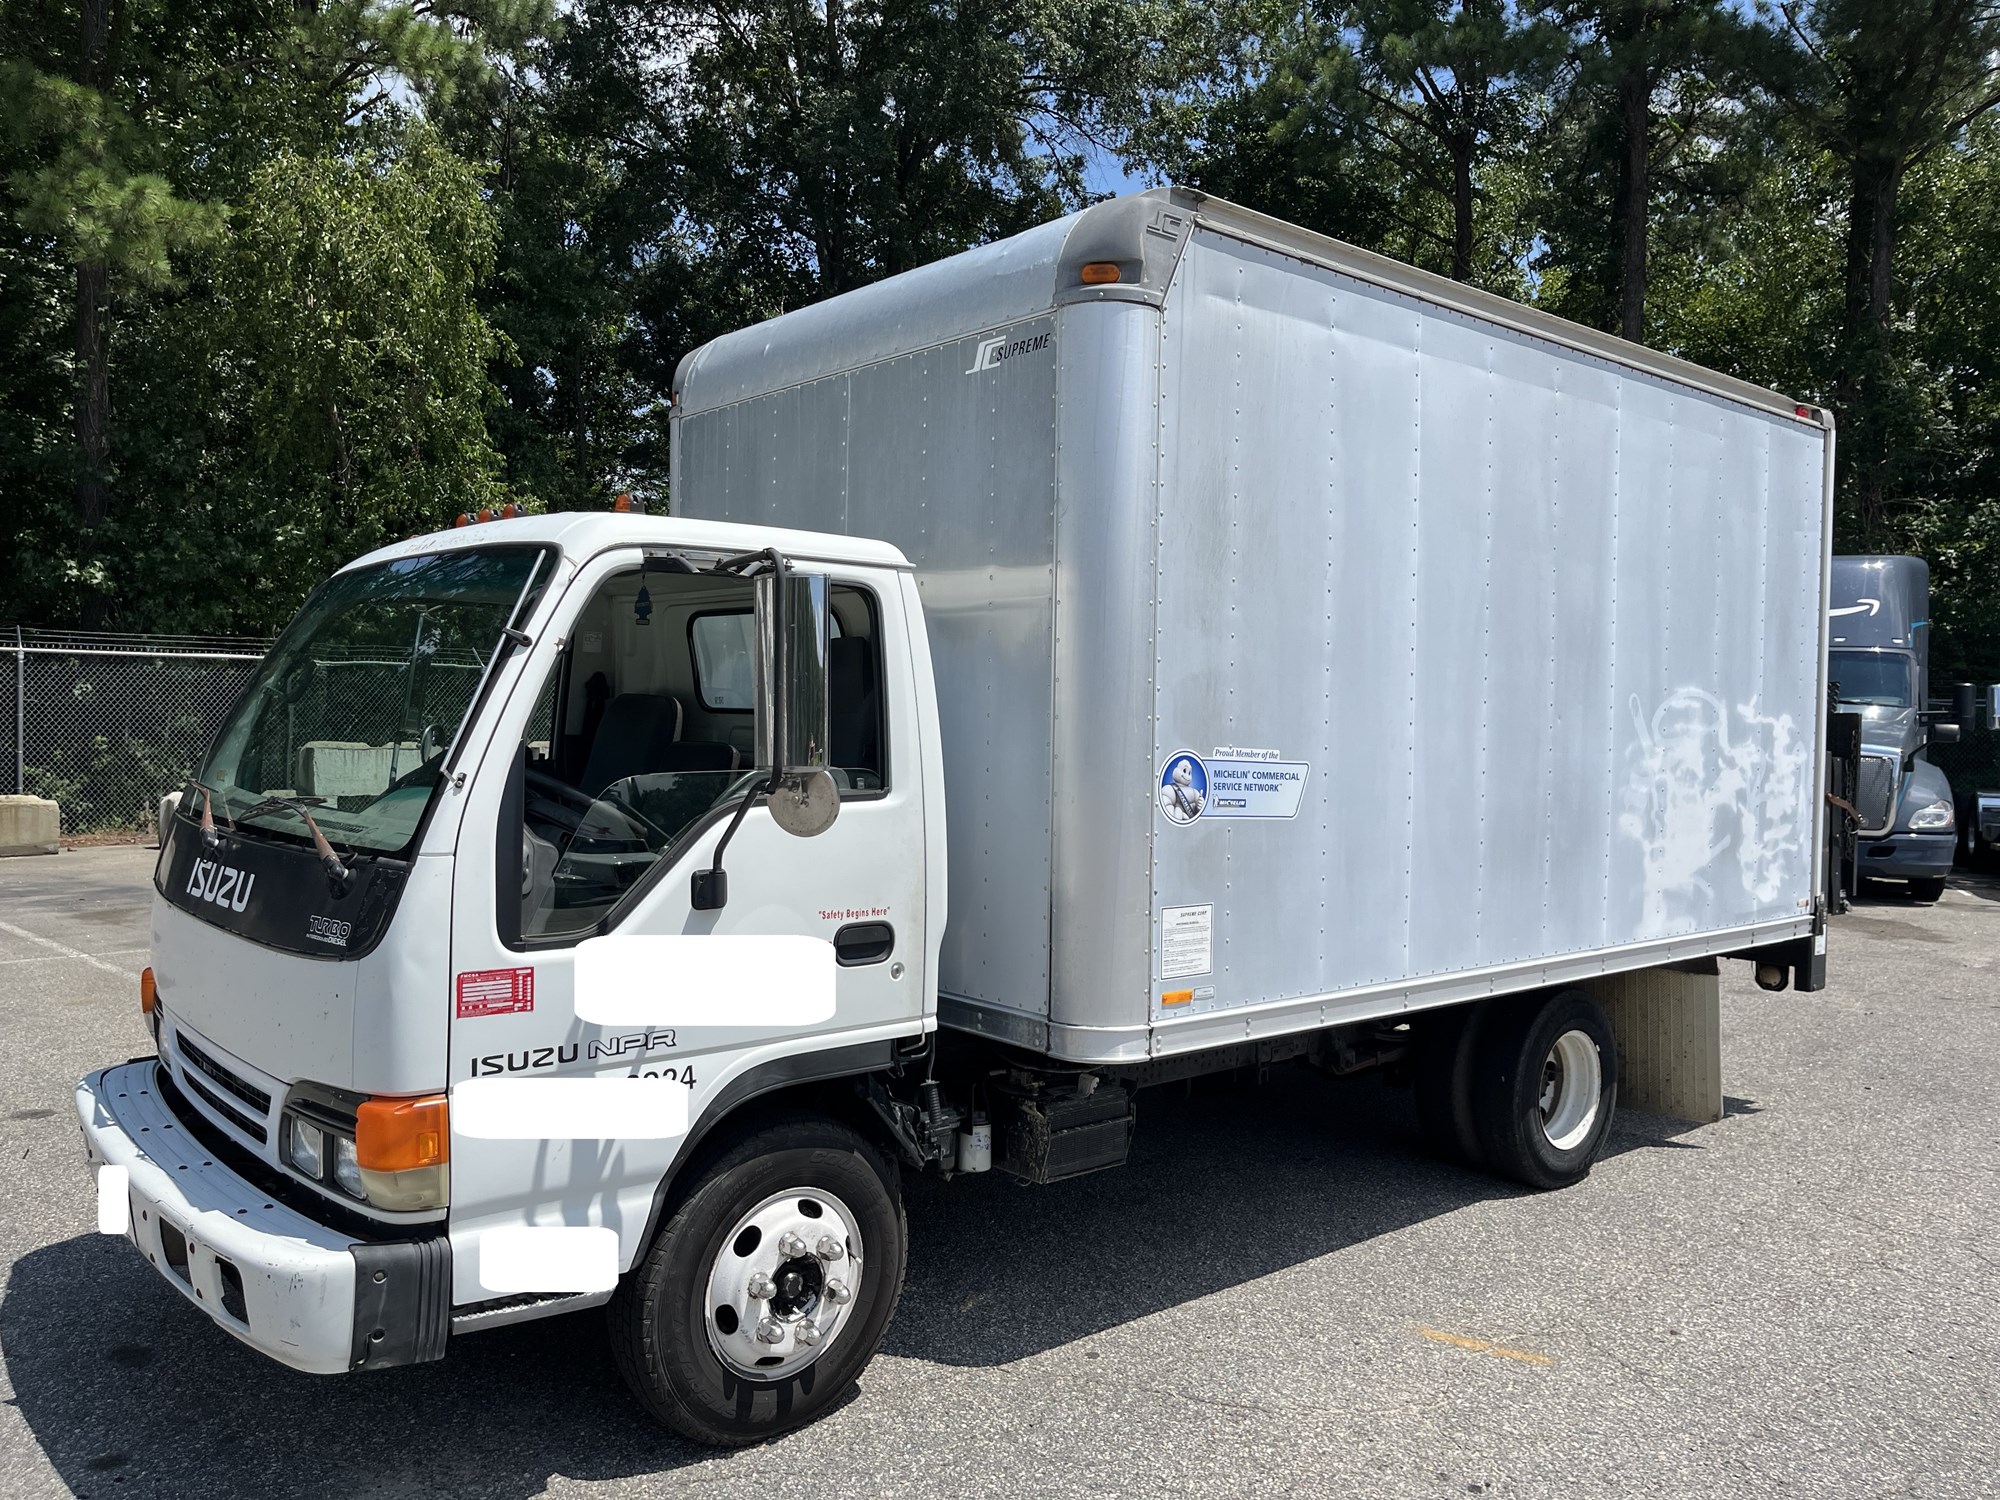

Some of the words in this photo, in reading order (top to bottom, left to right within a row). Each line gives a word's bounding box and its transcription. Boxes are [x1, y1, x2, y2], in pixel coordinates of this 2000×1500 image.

[996, 333, 1051, 362] SUPREME
[1214, 748, 1235, 757] Proud
[1235, 749, 1260, 759] Member
[1261, 751, 1269, 761] of
[1268, 751, 1279, 760] the
[1251, 771, 1300, 781] COMMERCIAL
[1213, 782, 1242, 791] SERVICE
[186, 857, 256, 913] ISUZU
[818, 909, 845, 921] "Safety
[846, 908, 870, 919] Begins
[871, 906, 891, 916] Here"
[309, 914, 352, 939] TURBO
[327, 936, 347, 947] DIESEL
[471, 1043, 579, 1077] ISUZU
[587, 1029, 677, 1060] NPR
